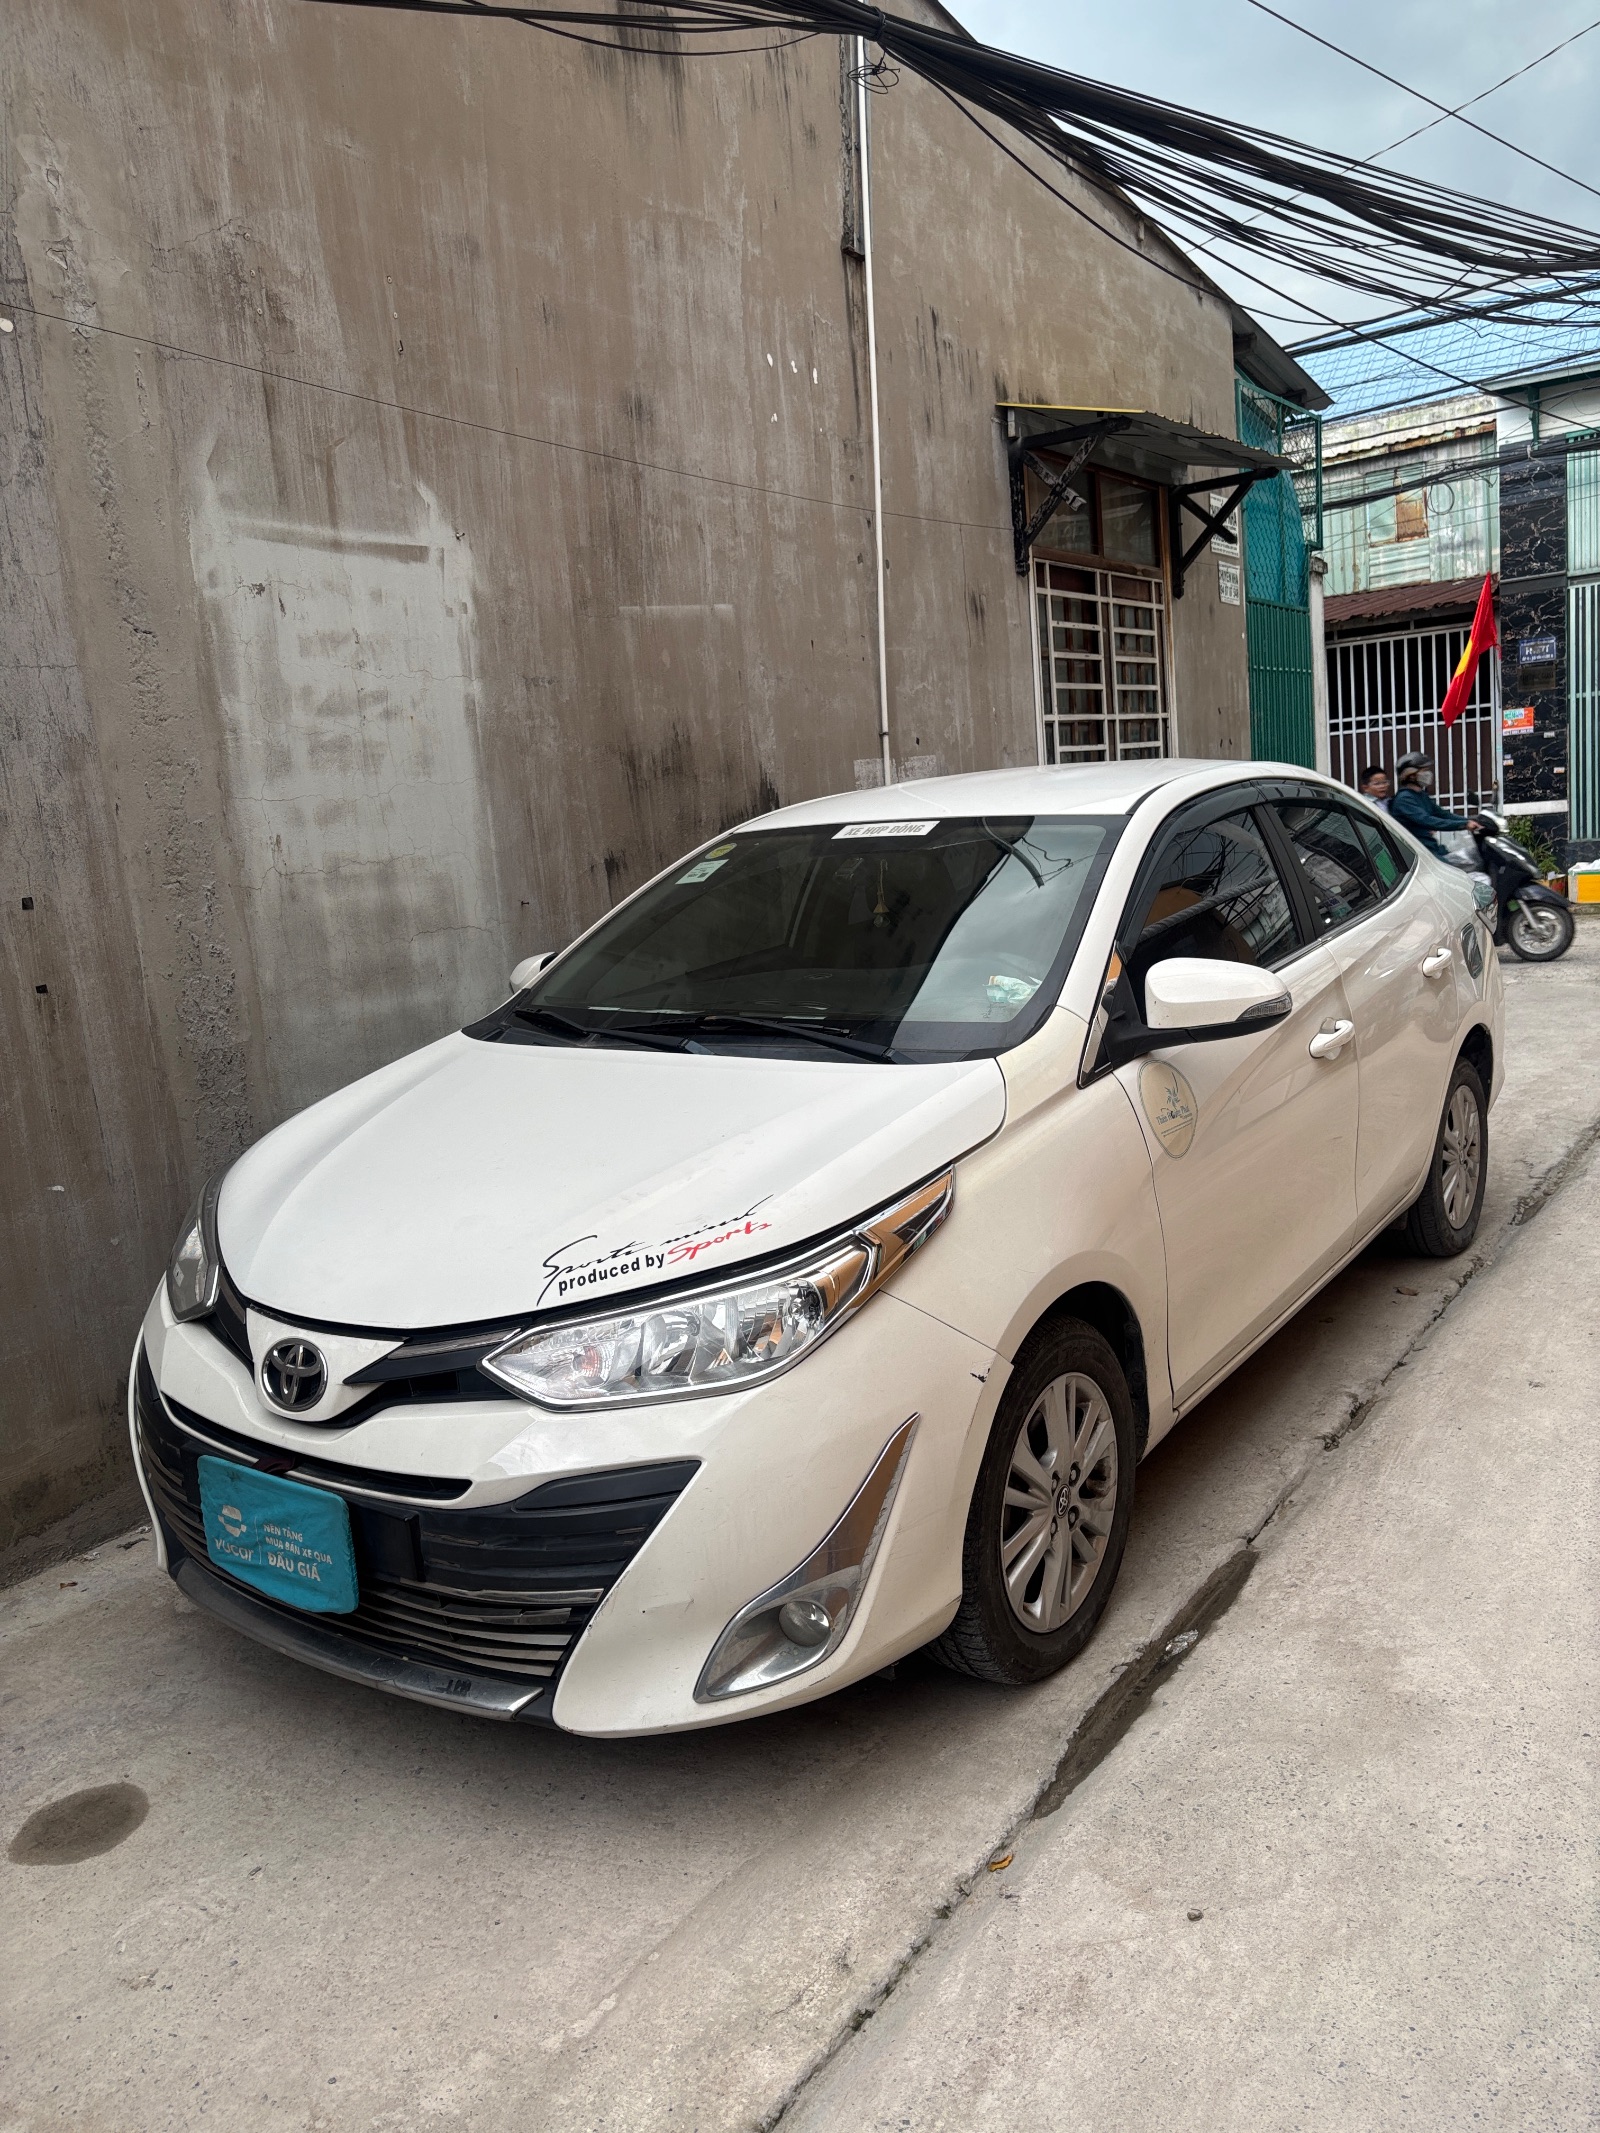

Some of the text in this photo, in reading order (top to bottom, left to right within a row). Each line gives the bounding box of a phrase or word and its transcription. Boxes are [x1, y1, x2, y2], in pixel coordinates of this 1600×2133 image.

[844, 827, 863, 836] XE
[558, 1220, 772, 1297] produced by Sports
[265, 1536, 333, 1565] MUA BÁN XE QUA
[267, 1550, 321, 1582] ĐẤU GIÁ
